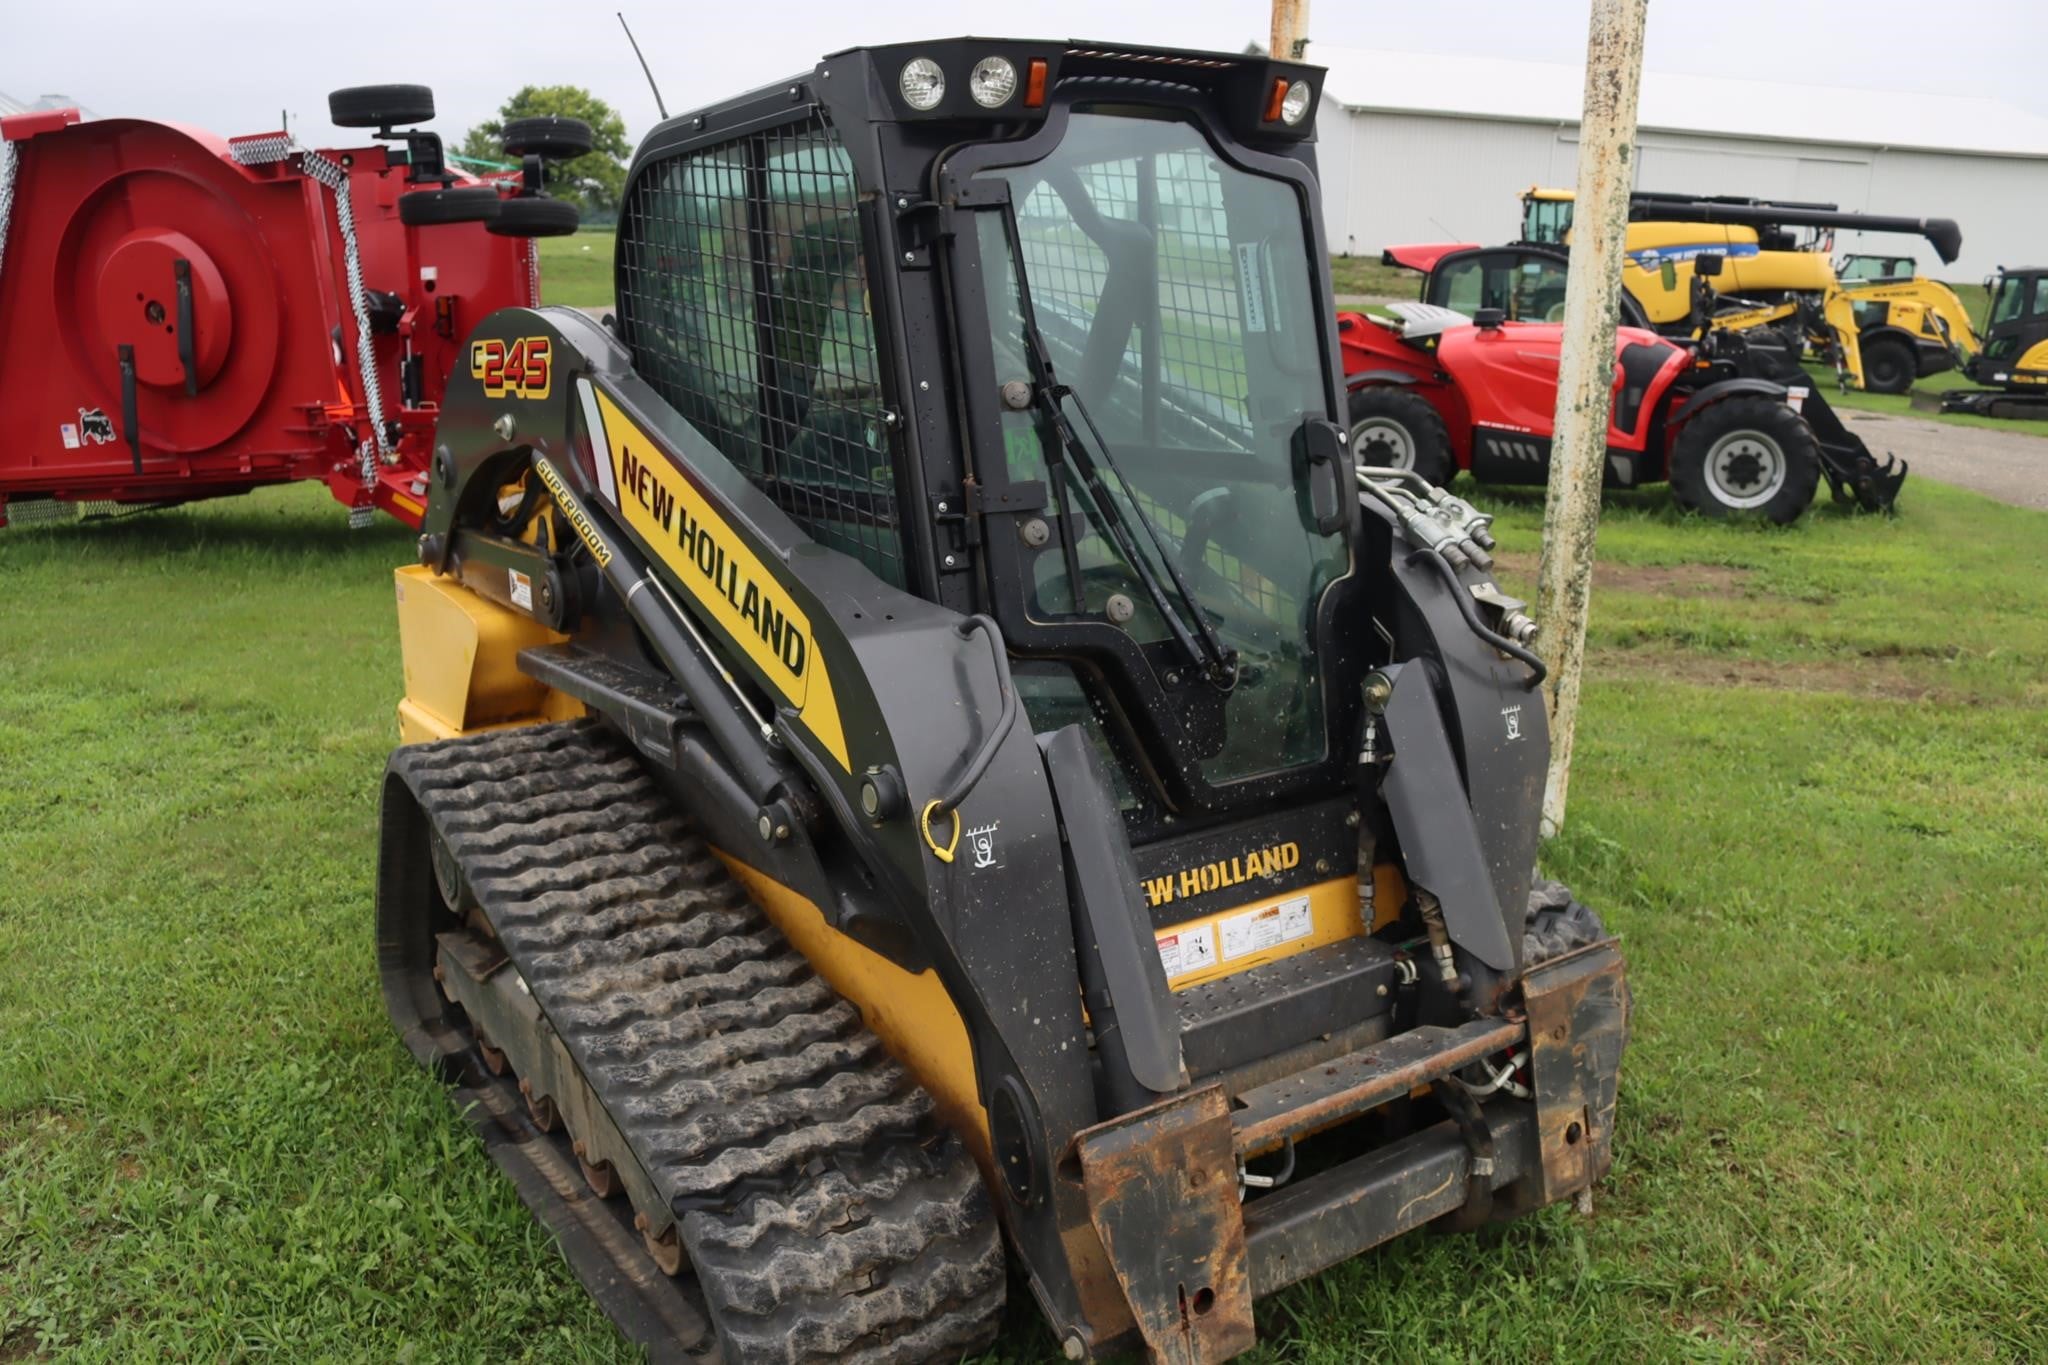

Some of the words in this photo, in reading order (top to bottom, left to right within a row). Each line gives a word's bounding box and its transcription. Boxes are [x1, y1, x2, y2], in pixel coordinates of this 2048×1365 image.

[622, 445, 675, 534] NEW
[678, 506, 806, 678] HOLLAND
[1180, 841, 1300, 898] HOLLAND
